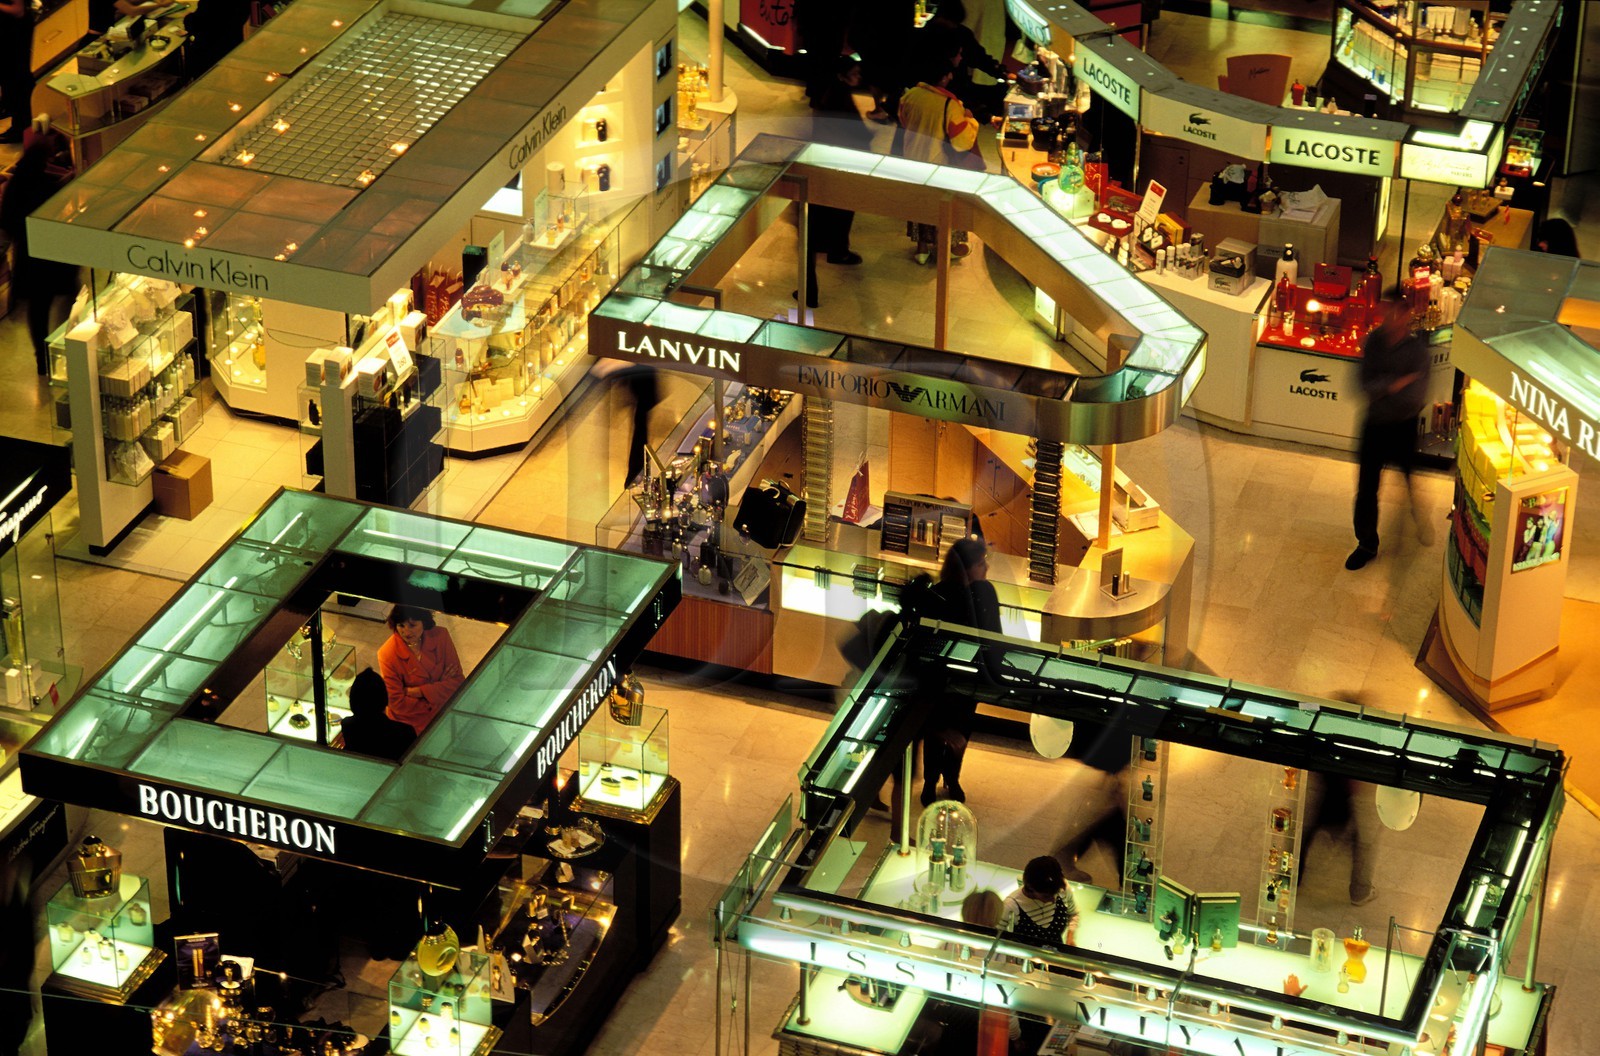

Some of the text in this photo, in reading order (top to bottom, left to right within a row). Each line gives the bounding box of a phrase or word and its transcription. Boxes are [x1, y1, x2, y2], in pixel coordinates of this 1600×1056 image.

[1083, 57, 1131, 105] LACOSTE
[509, 102, 567, 170] Calvin Klein
[1183, 125, 1217, 141] LACOSTE
[1284, 138, 1380, 166] LACOSTE
[127, 245, 269, 291] Calvin Klein
[618, 331, 740, 372] LANVIN
[798, 365, 1005, 422] EMPORIO ARMANI
[1290, 385, 1338, 401] LACOSTE
[1509, 371, 1571, 440] NINA
[537, 654, 617, 780] BOUCHERON
[138, 784, 336, 855] BOUCHERON
[809, 941, 1018, 1006] ISSEY
